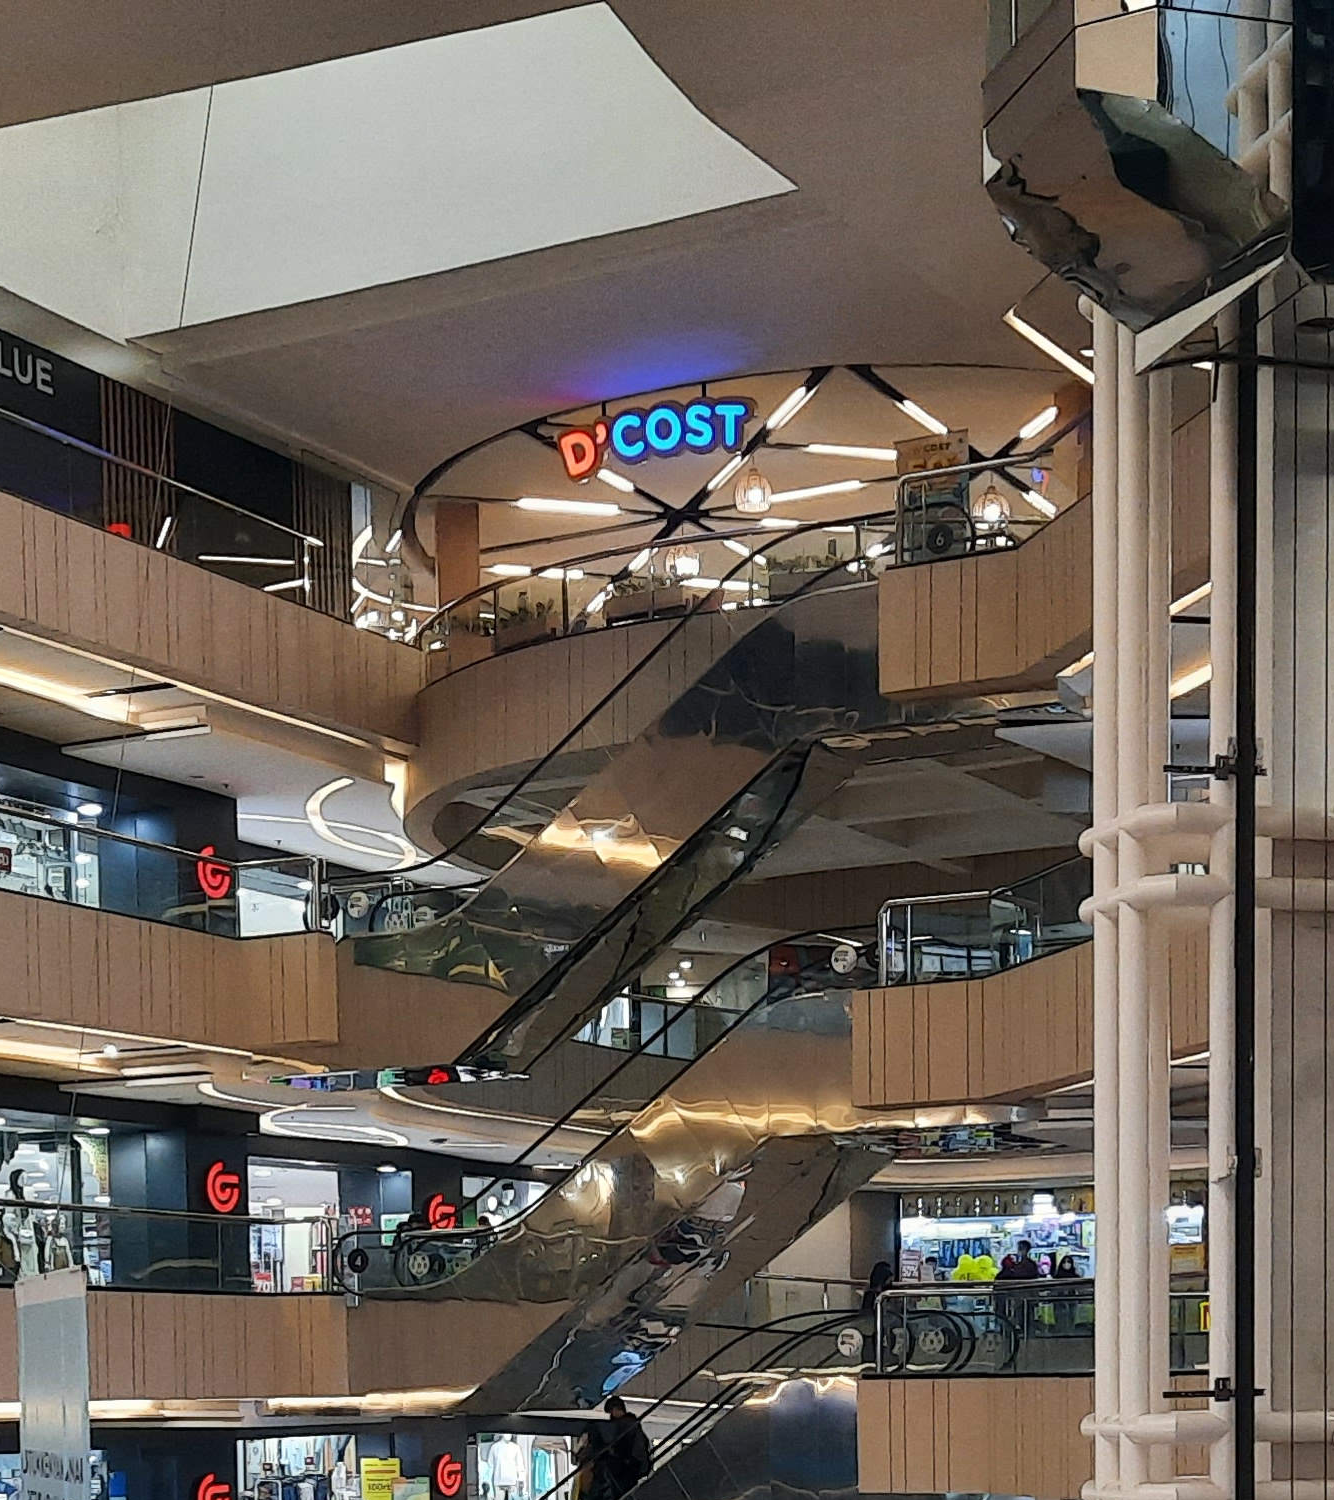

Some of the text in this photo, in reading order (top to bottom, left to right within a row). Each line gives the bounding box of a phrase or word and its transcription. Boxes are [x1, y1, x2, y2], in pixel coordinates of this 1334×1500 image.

[559, 403, 746, 478] D'COST
[935, 531, 944, 547] 6
[354, 1255, 362, 1266] 4
